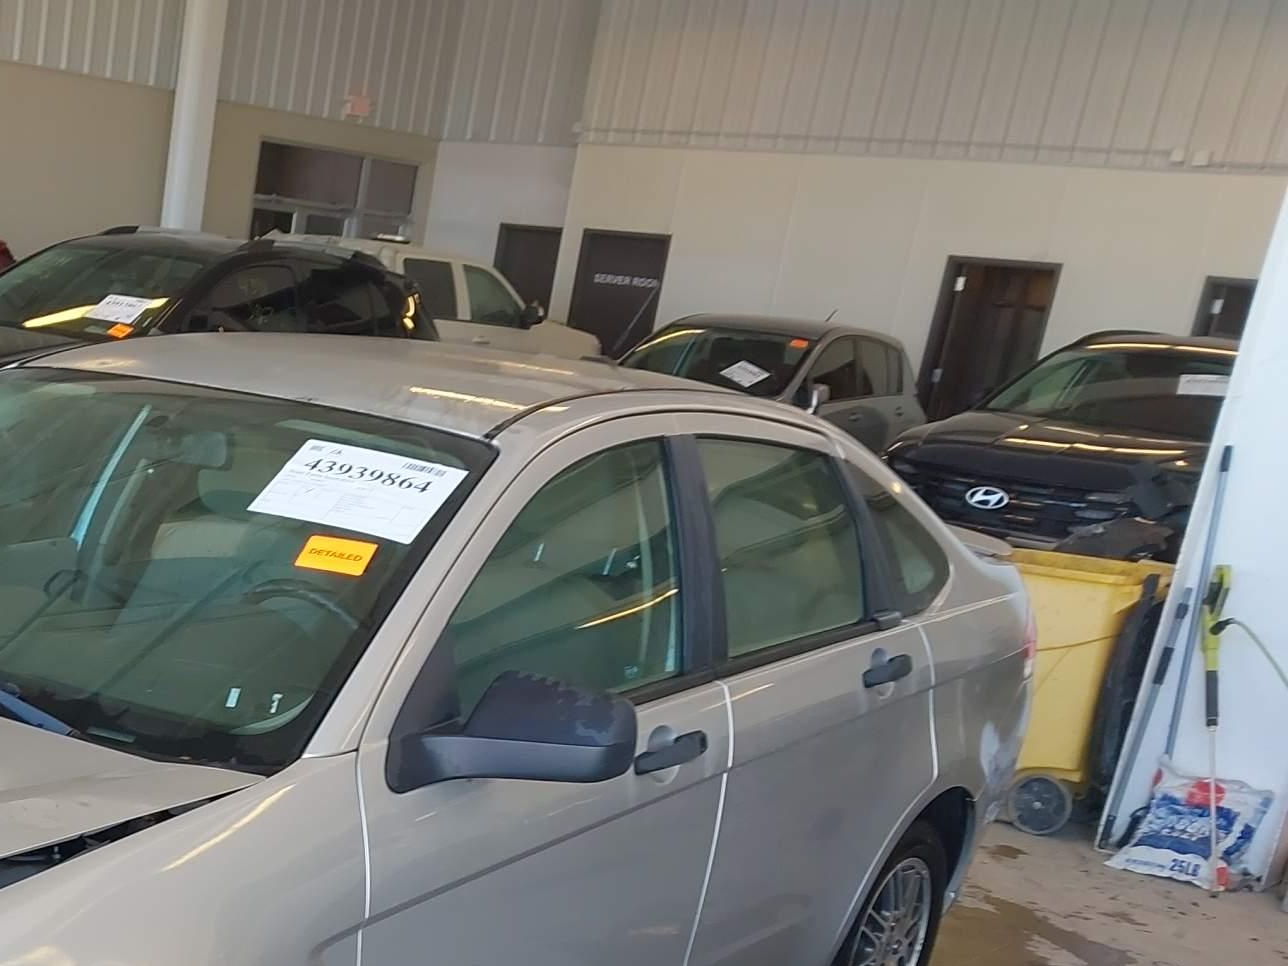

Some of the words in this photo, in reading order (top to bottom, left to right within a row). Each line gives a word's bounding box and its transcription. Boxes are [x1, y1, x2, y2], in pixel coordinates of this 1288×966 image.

[593, 273, 632, 286] SERVER
[303, 458, 433, 493] 43939864
[308, 547, 363, 562] DETAILED
